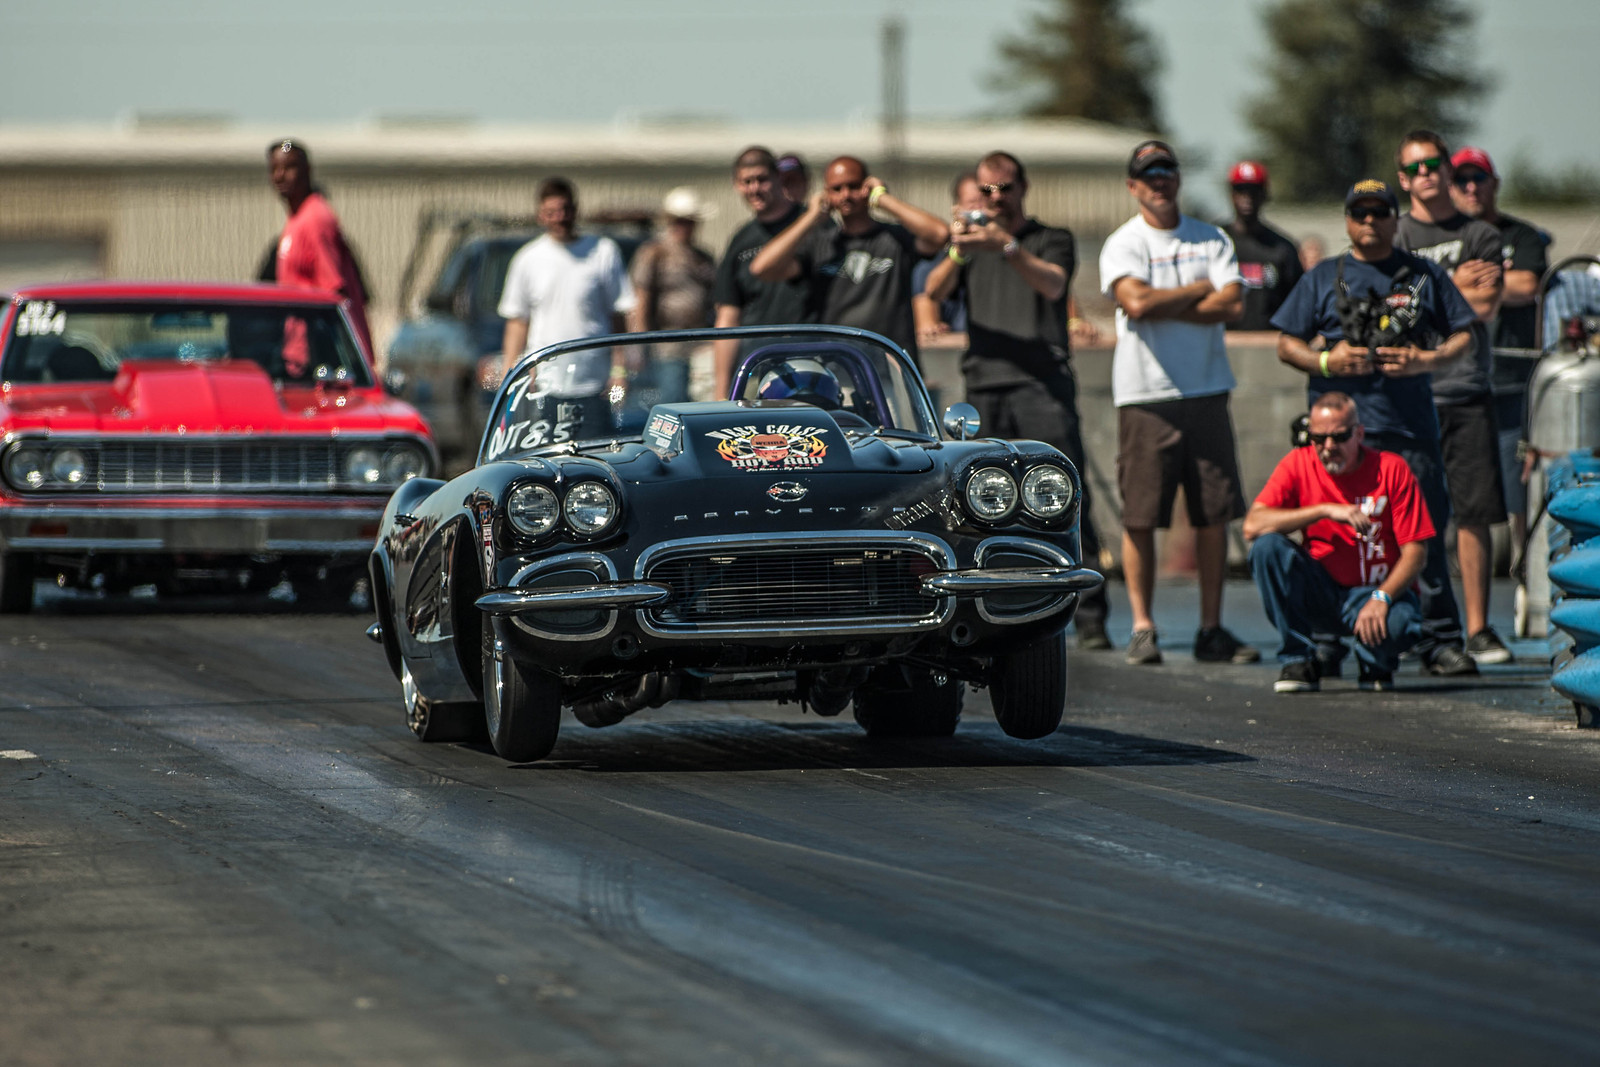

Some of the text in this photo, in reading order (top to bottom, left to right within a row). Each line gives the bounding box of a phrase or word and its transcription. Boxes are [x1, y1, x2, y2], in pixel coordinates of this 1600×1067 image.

[704, 424, 829, 441] WEST COAST
[731, 456, 824, 467] HOT ROD
